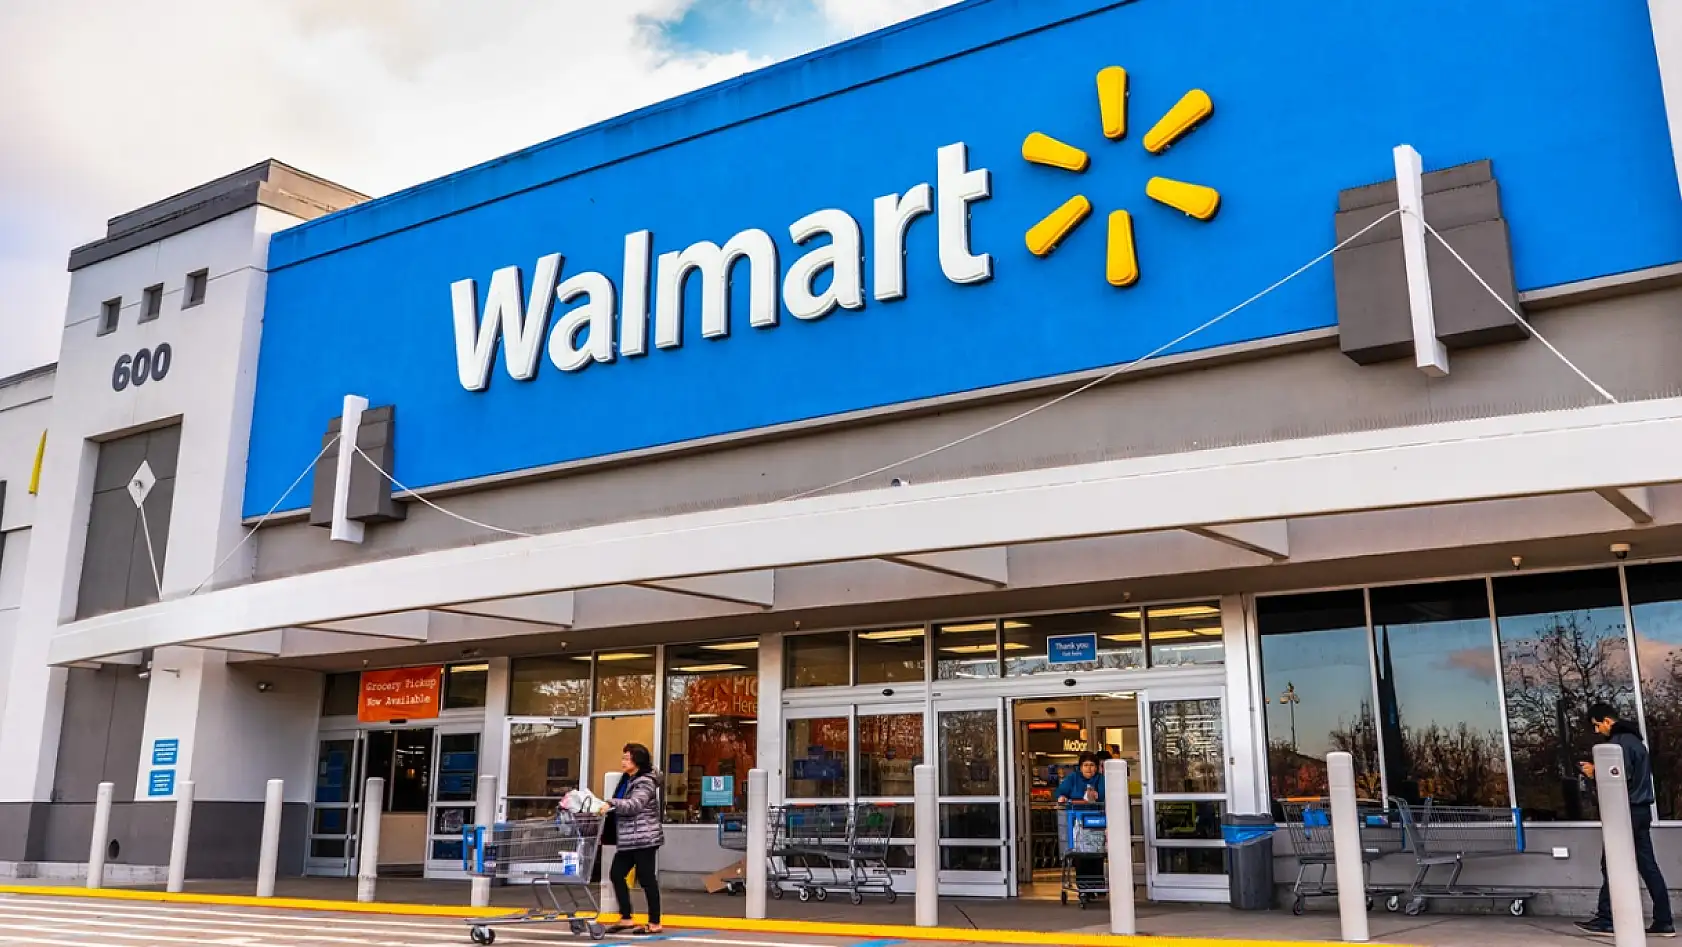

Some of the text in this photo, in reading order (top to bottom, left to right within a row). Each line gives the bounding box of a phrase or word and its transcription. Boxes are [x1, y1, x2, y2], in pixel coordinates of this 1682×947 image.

[450, 141, 993, 392] Walmart
[112, 342, 171, 391] 600
[1055, 642, 1089, 651] Thank you
[366, 678, 436, 692] Grocery Pickup
[366, 693, 431, 707] Now Available
